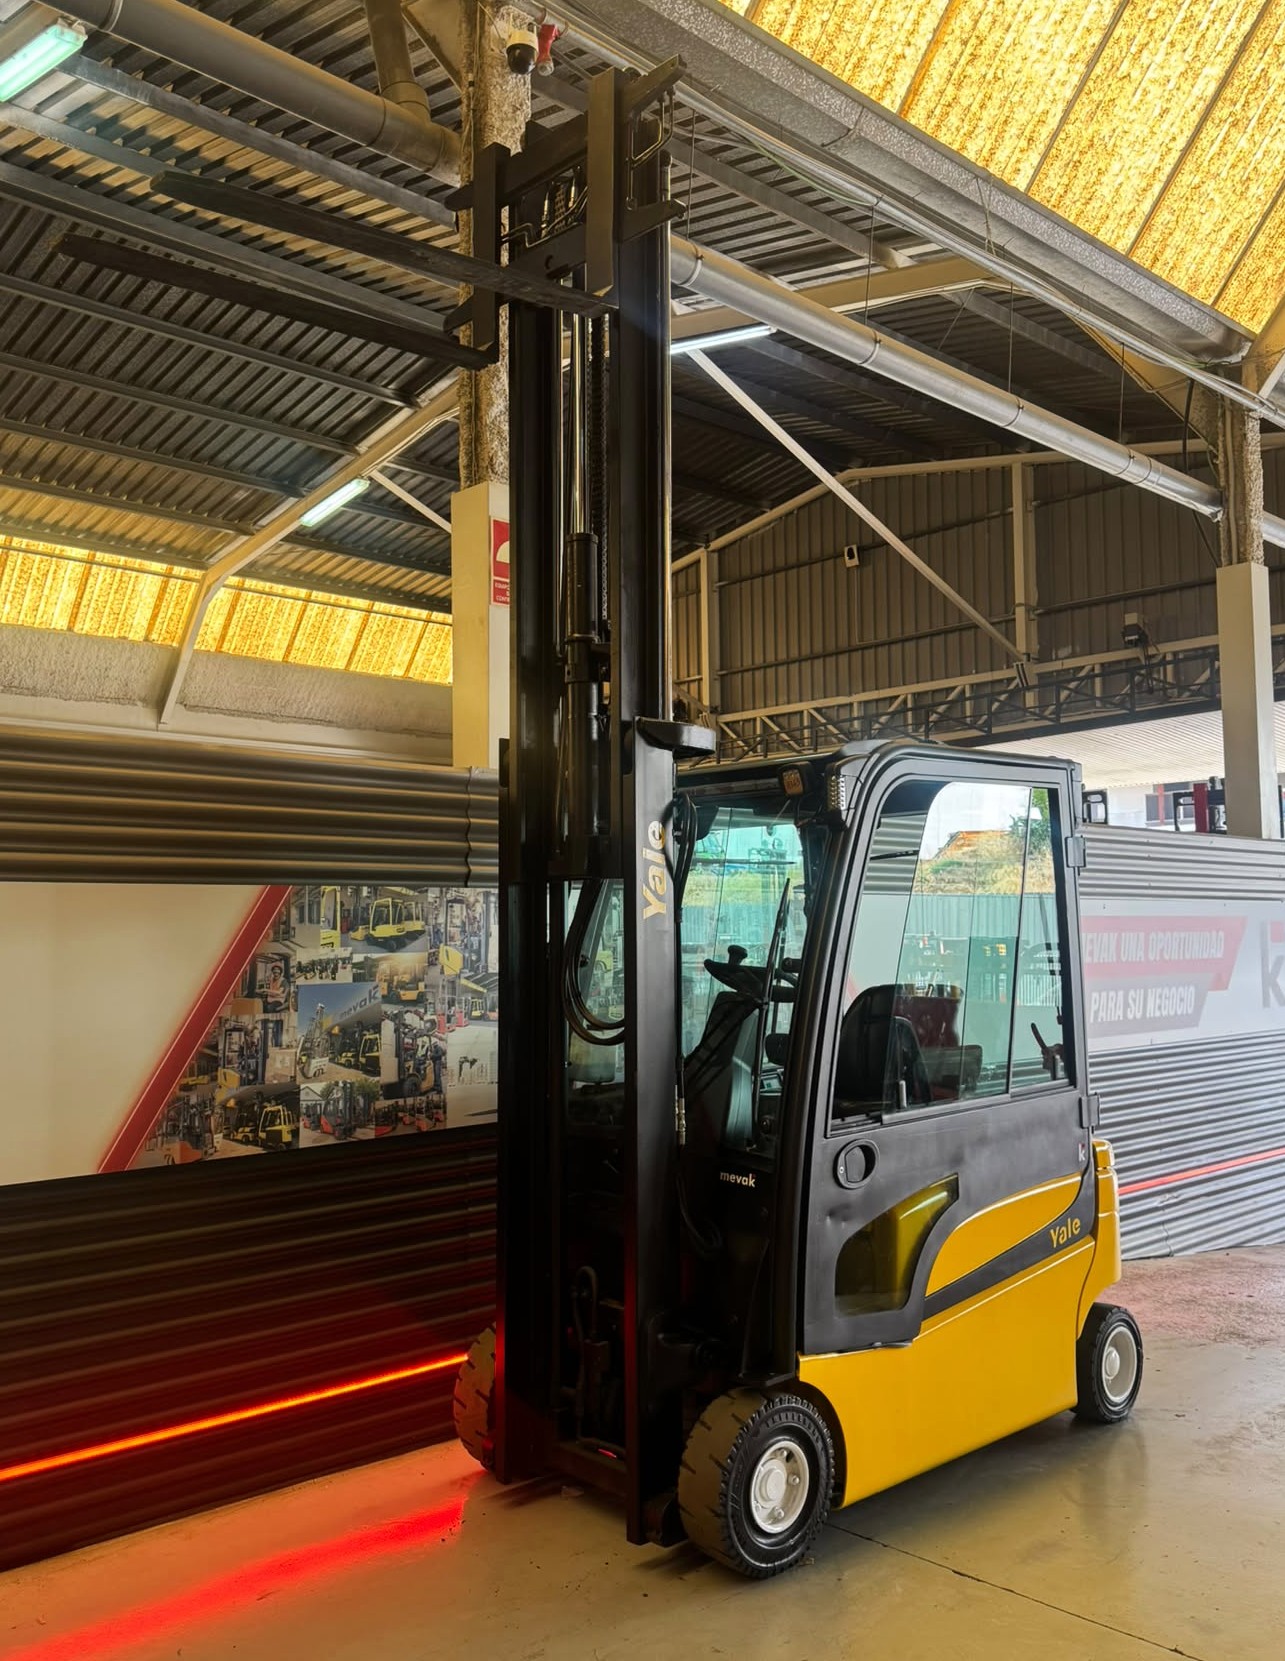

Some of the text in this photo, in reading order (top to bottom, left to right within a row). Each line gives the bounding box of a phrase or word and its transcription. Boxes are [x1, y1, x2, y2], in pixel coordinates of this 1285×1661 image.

[642, 820, 667, 920] Yale
[1121, 931, 1145, 962] UNA
[1148, 930, 1224, 961] OPORTUNIDAD
[1090, 985, 1196, 1023] PARA SU NEGOCIO
[720, 1172, 756, 1187] mevak
[1050, 1218, 1081, 1248] Yale
